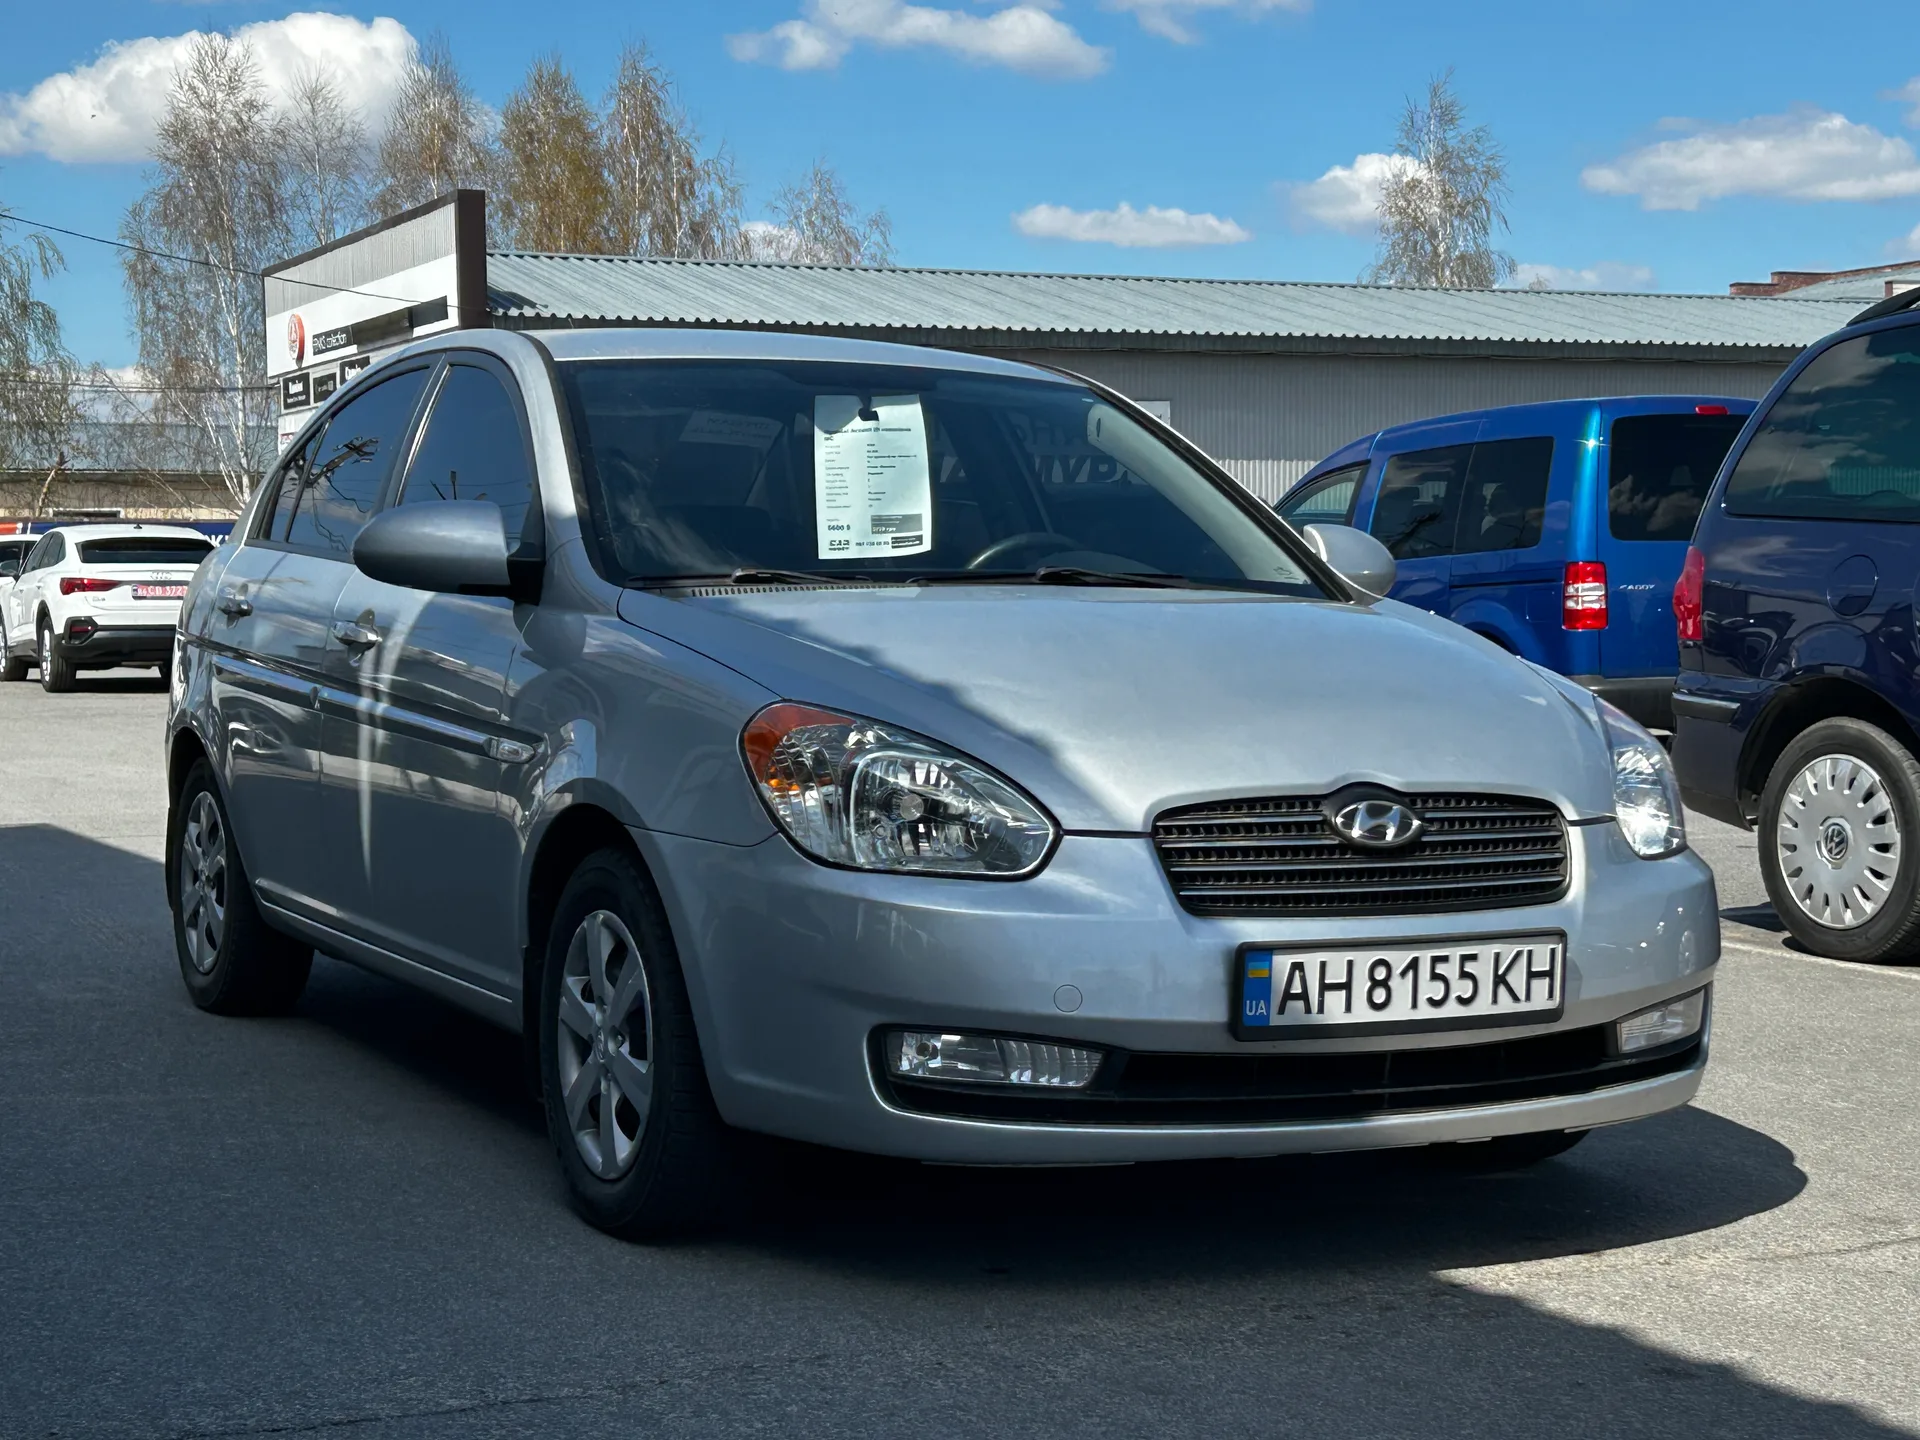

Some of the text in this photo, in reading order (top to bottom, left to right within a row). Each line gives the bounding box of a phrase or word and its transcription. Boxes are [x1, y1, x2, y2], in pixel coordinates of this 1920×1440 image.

[1276, 946, 1557, 1015] AH 8155 KH
[1246, 1000, 1267, 1015] UA
